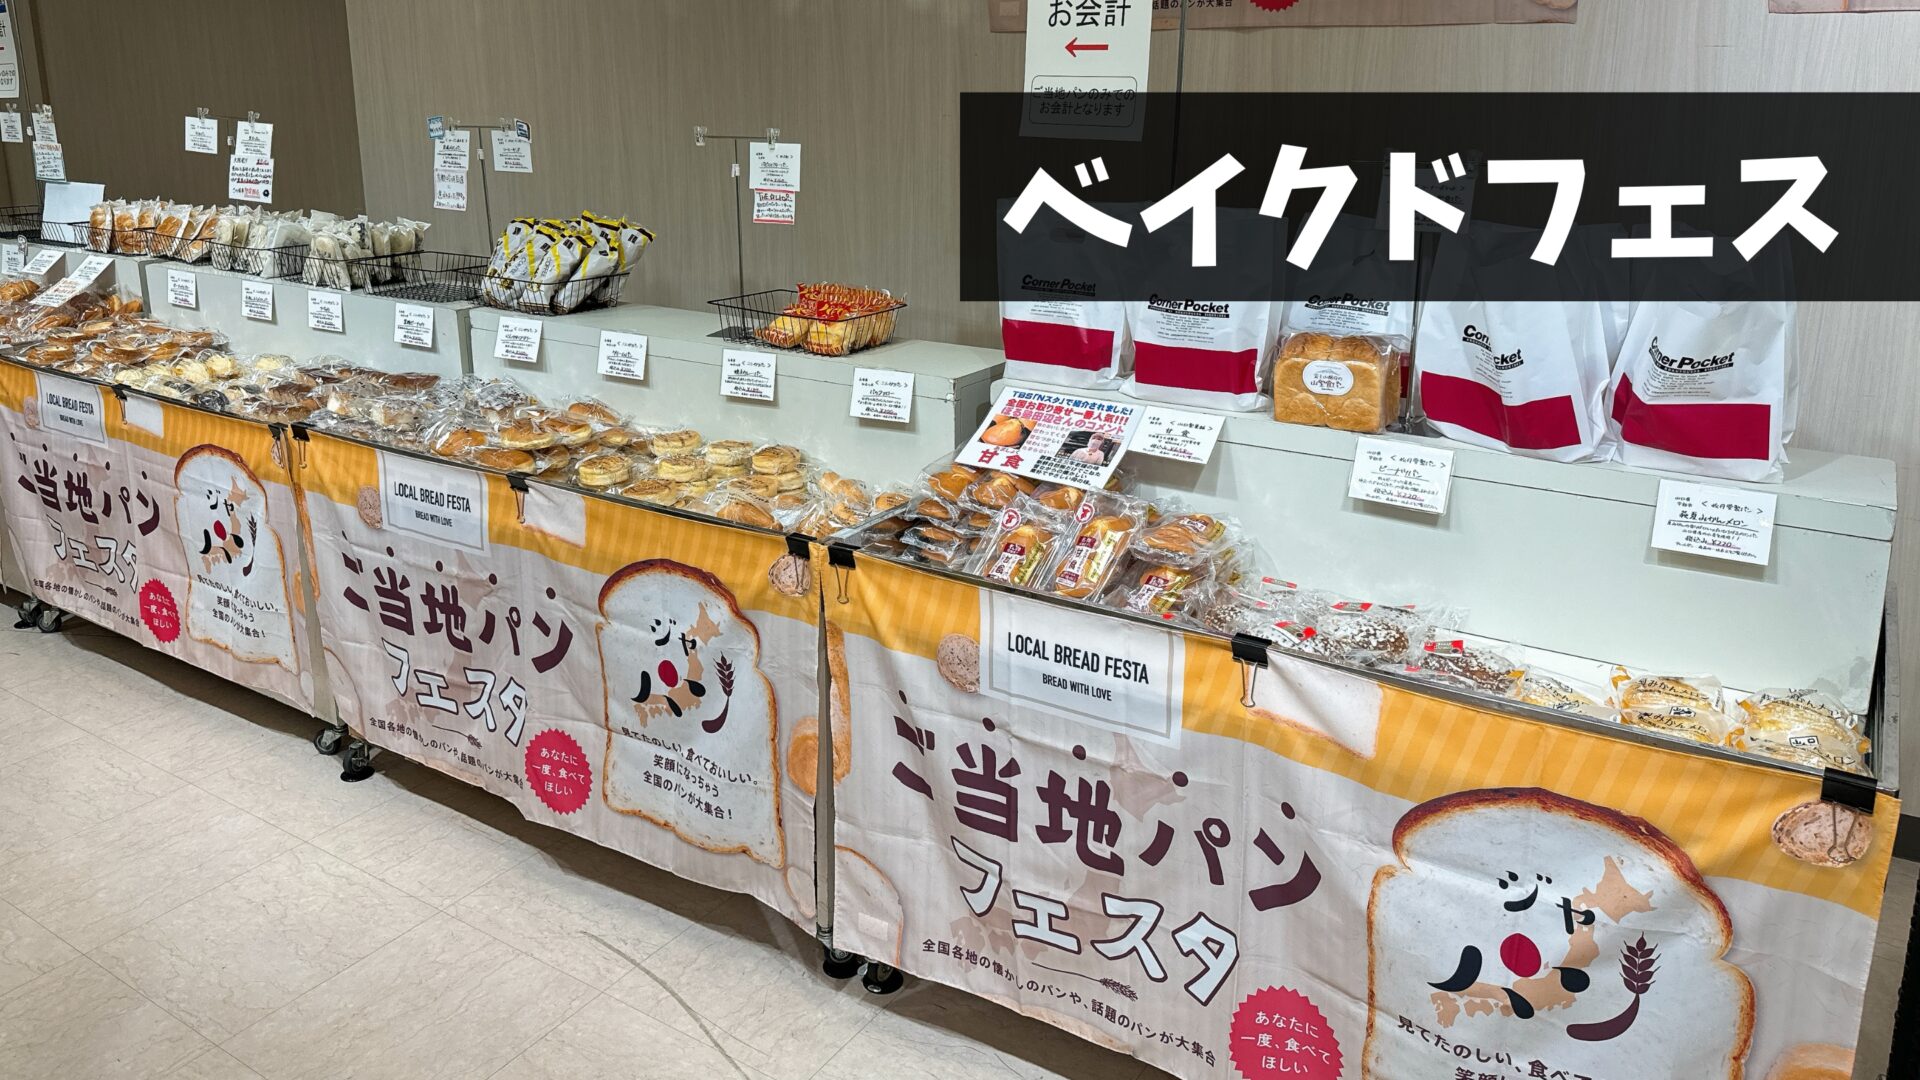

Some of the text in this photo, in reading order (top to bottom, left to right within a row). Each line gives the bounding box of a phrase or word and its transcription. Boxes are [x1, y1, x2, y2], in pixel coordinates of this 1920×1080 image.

[1048, 0, 1131, 27] お会計
[1033, 86, 1135, 101] ご当地パンのみでの
[1039, 101, 1126, 116] お会計となります
[1021, 274, 1096, 292] Corner Pocket
[1148, 293, 1230, 313] Corner Pocket
[1341, 293, 1391, 311] Pocket
[1677, 352, 1735, 369] Pocket
[46, 393, 94, 417] LOCAL BREAD FESTA
[978, 449, 1024, 470] 甘食
[394, 481, 471, 513] LOCAL BREAD FESTA
[415, 510, 452, 527] BREAD WITH LOVE
[153, 618, 173, 629] ほしい
[342, 552, 574, 674] ご当地パン
[1007, 632, 1150, 685] LOCAL BREAD FESTA
[382, 637, 528, 747] フェスタ
[1042, 673, 1112, 701] BREAD WITH LOVE
[540, 747, 578, 766] あなたに
[621, 726, 758, 785] 見てたのしい、食べておいしい。
[532, 763, 586, 786] 一度、食べて
[653, 754, 720, 797] 笑顔になっちゃう
[544, 780, 574, 797] ほしい
[643, 771, 733, 820] 全国のパンが大集合!
[892, 715, 1322, 911] ご当地パン
[951, 836, 1240, 1007] フェスタ
[922, 938, 1217, 1068] 全国各地の懐かしのパンや、話題のパンが大集合
[1254, 1010, 1319, 1038] あなたに
[1240, 1032, 1331, 1065] 一度、食べて
[1261, 1056, 1308, 1075] ほしい
